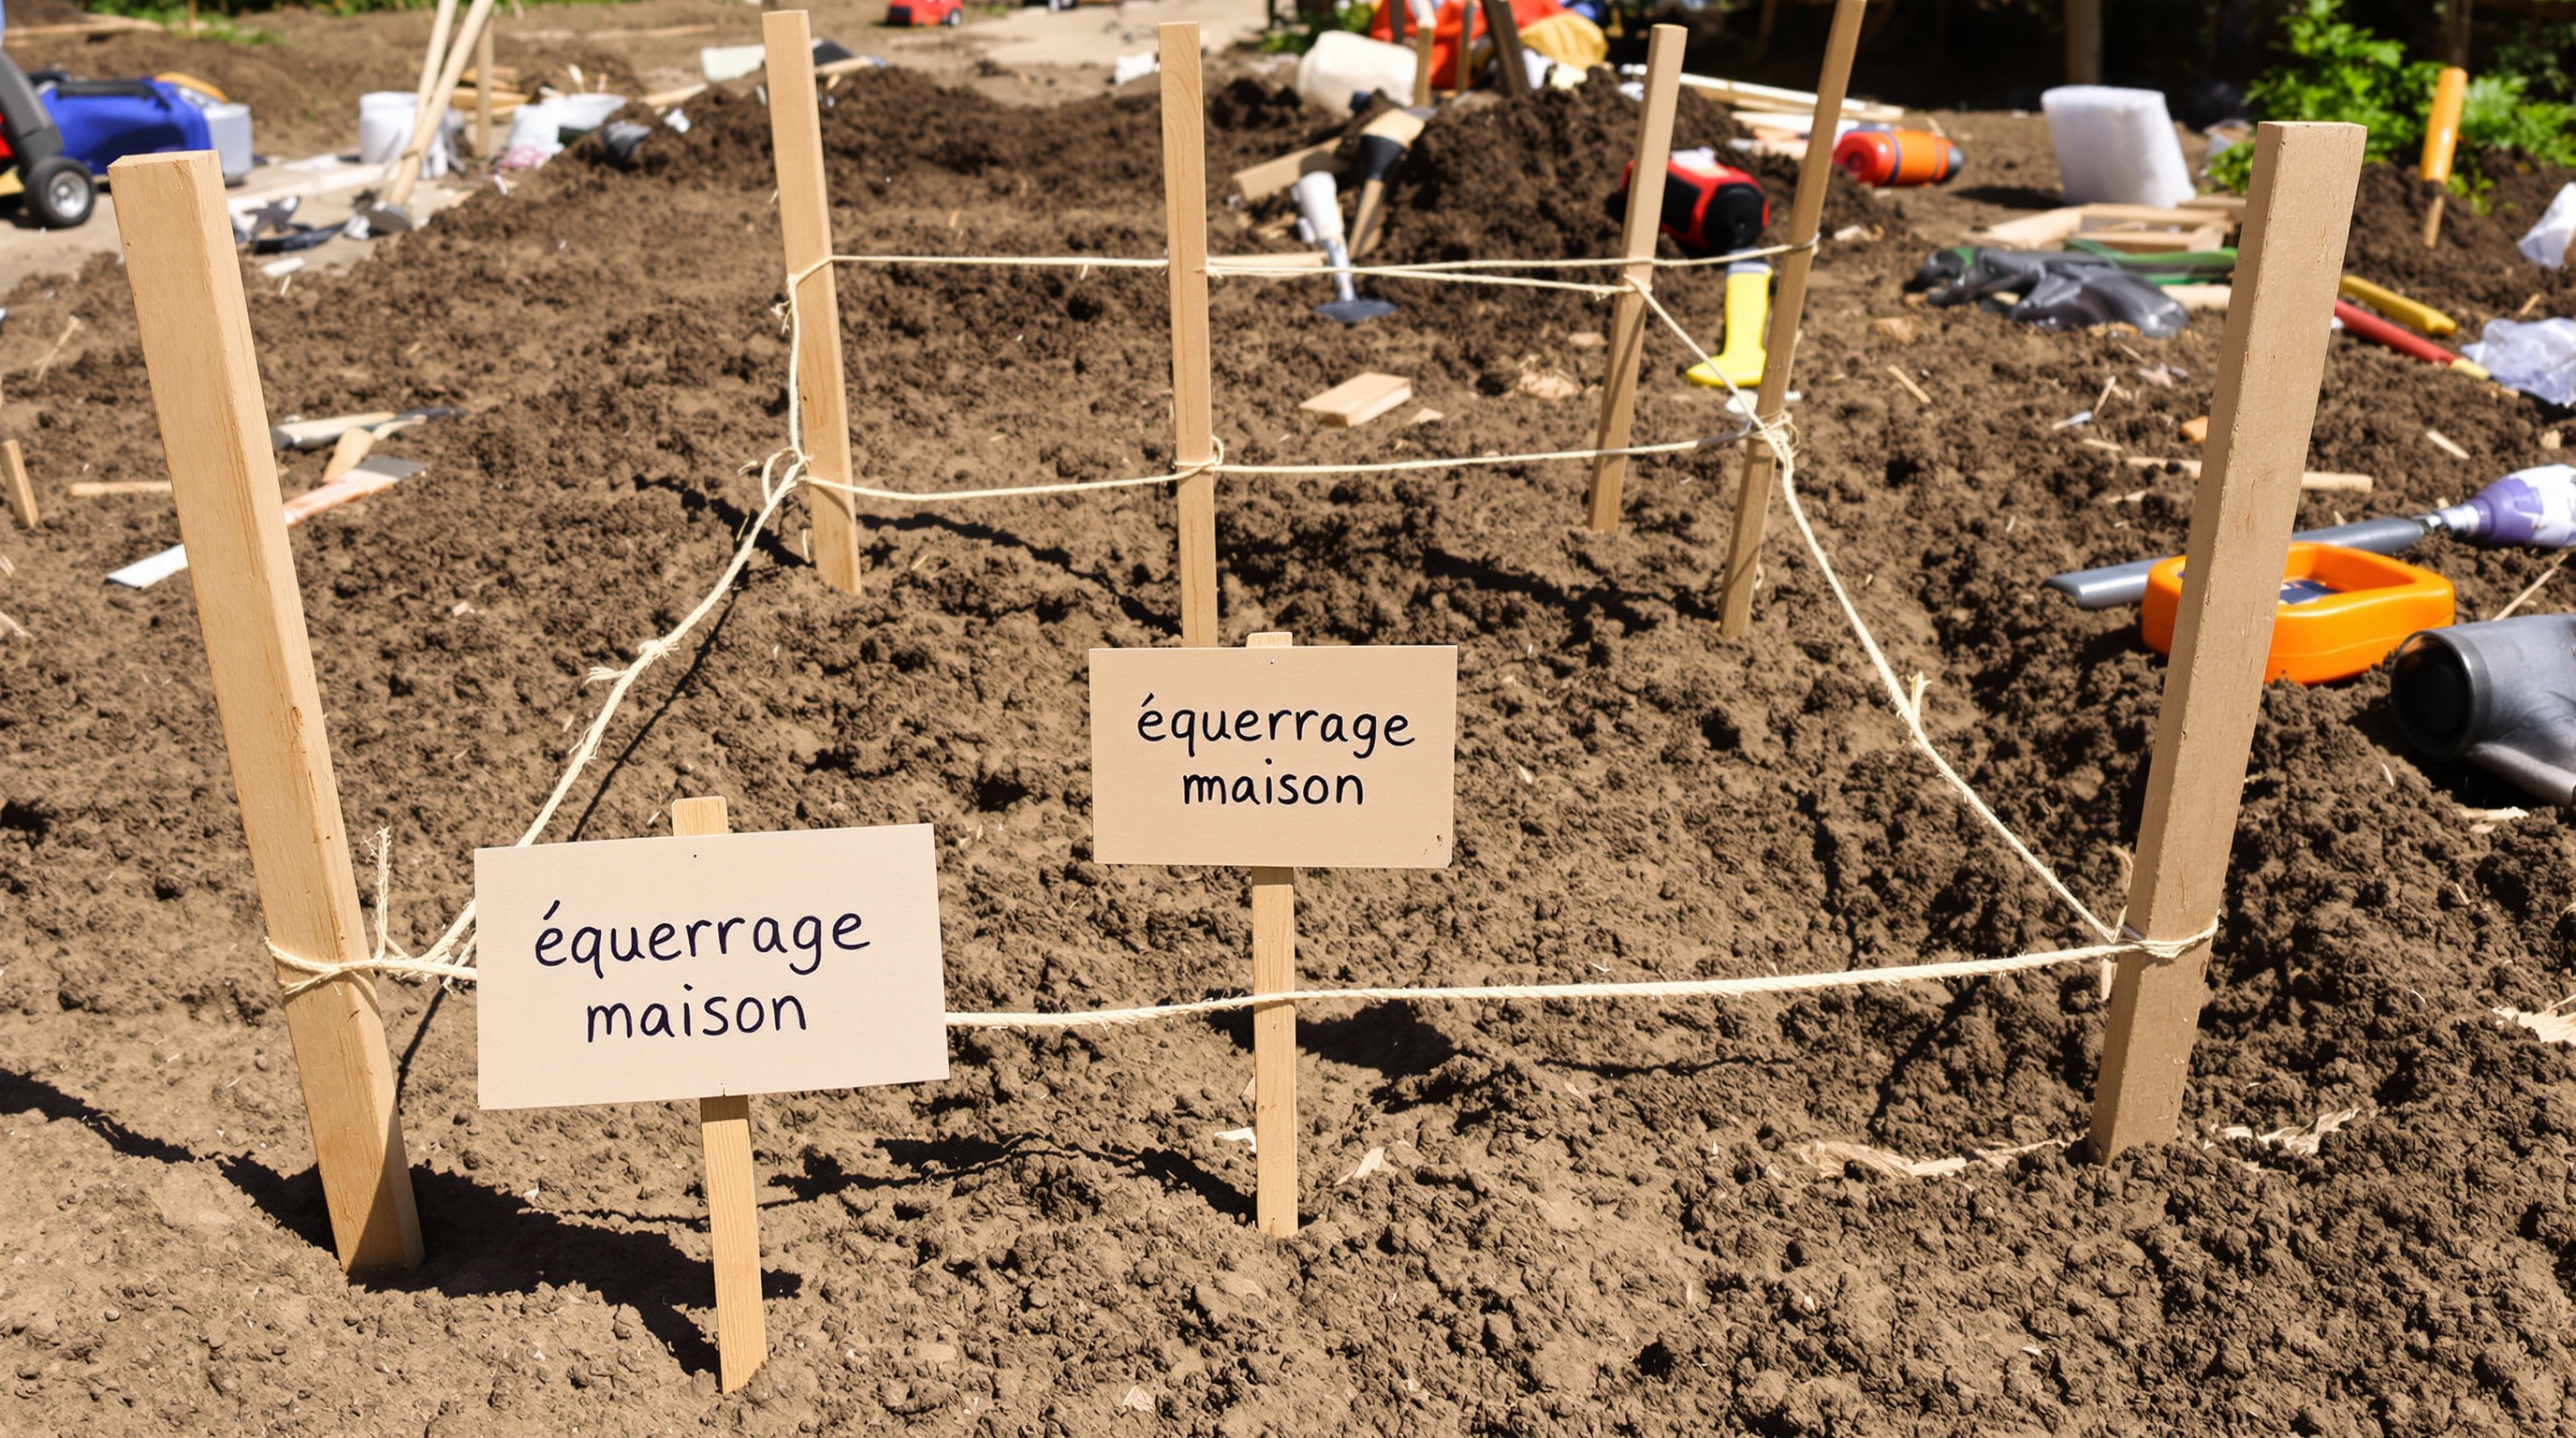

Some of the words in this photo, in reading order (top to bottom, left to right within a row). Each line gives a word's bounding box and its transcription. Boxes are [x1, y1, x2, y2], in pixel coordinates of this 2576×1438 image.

[1137, 692, 1416, 759] équerrage
[1182, 757, 1364, 806] maison
[534, 899, 871, 980] équerrage
[586, 983, 807, 1043] maison
